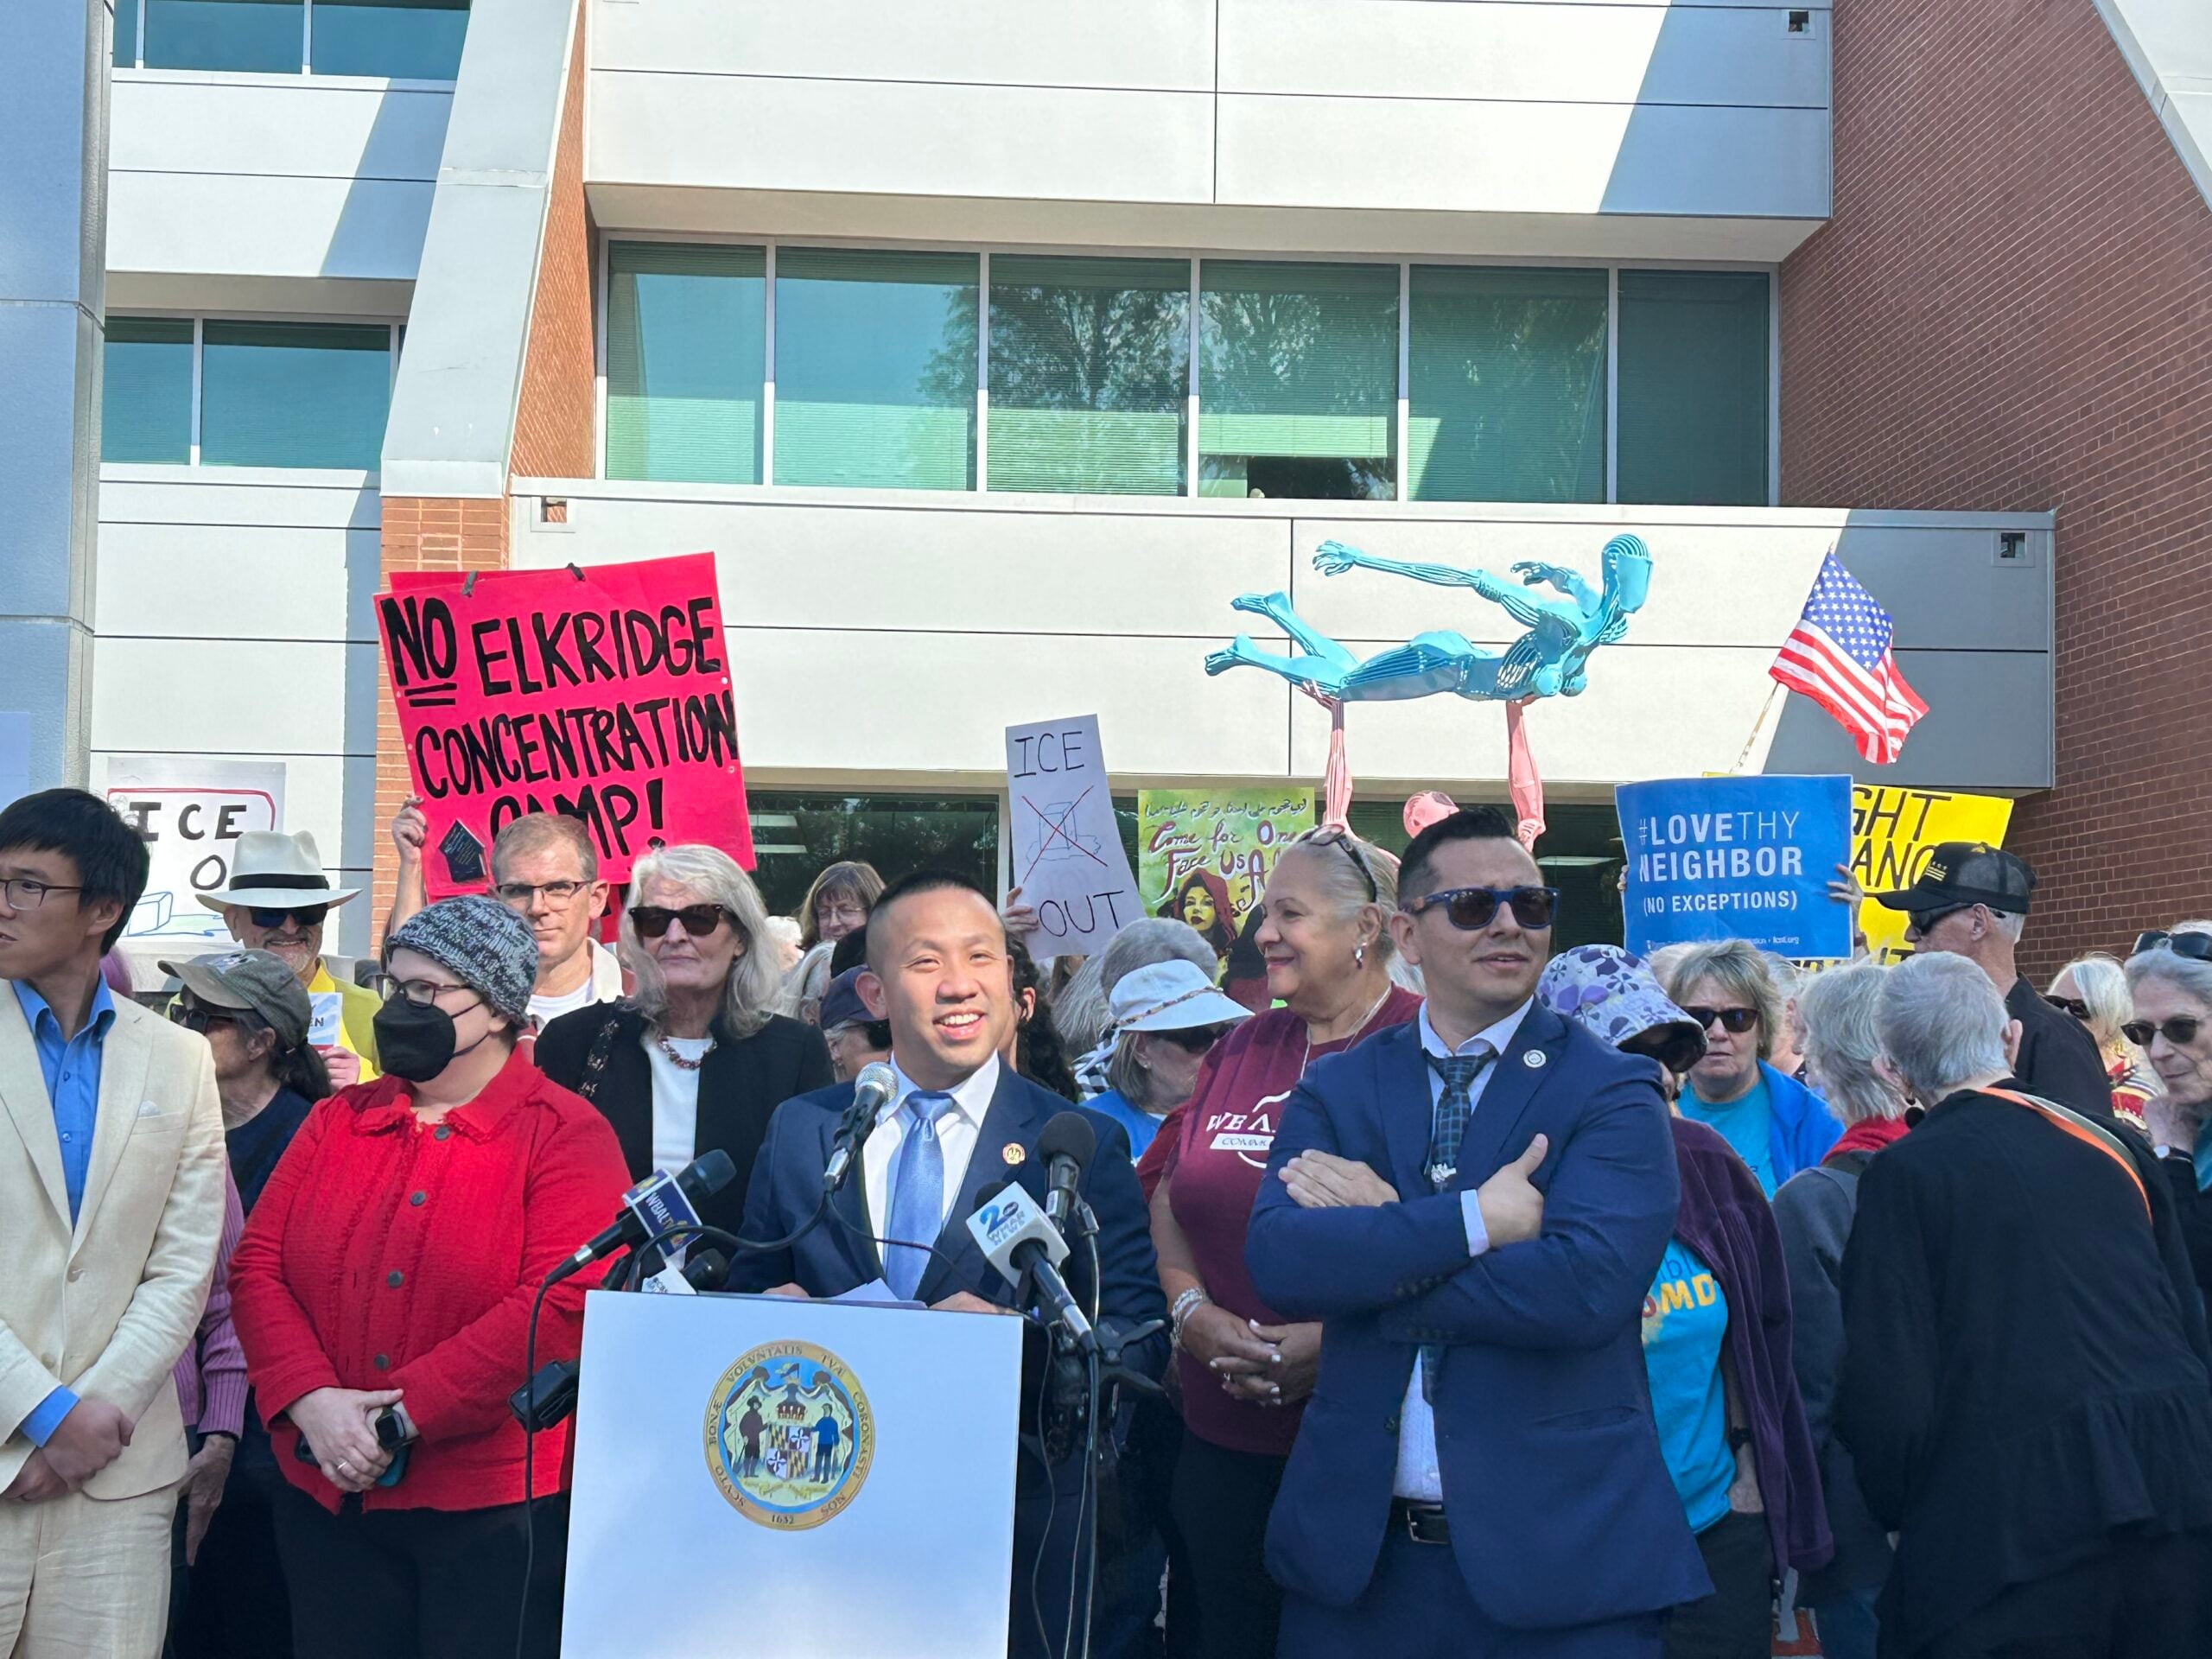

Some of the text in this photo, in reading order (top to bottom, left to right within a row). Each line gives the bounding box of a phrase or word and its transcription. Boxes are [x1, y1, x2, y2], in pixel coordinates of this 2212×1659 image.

[380, 596, 721, 696] NO ELKRIDGE
[415, 690, 738, 798] CONCENTRATION
[1014, 731, 1084, 778] ICE
[130, 802, 246, 842] ICE
[490, 778, 666, 860] CMP!
[1147, 821, 1201, 853] Come
[1207, 818, 1244, 852] for
[1161, 845, 1211, 899] Face
[1220, 849, 1245, 874] Us
[1639, 847, 1802, 882] NEIGHBOR
[1039, 891, 1124, 937] OUT
[1643, 890, 1797, 917] (NO EXCEPTIONS)
